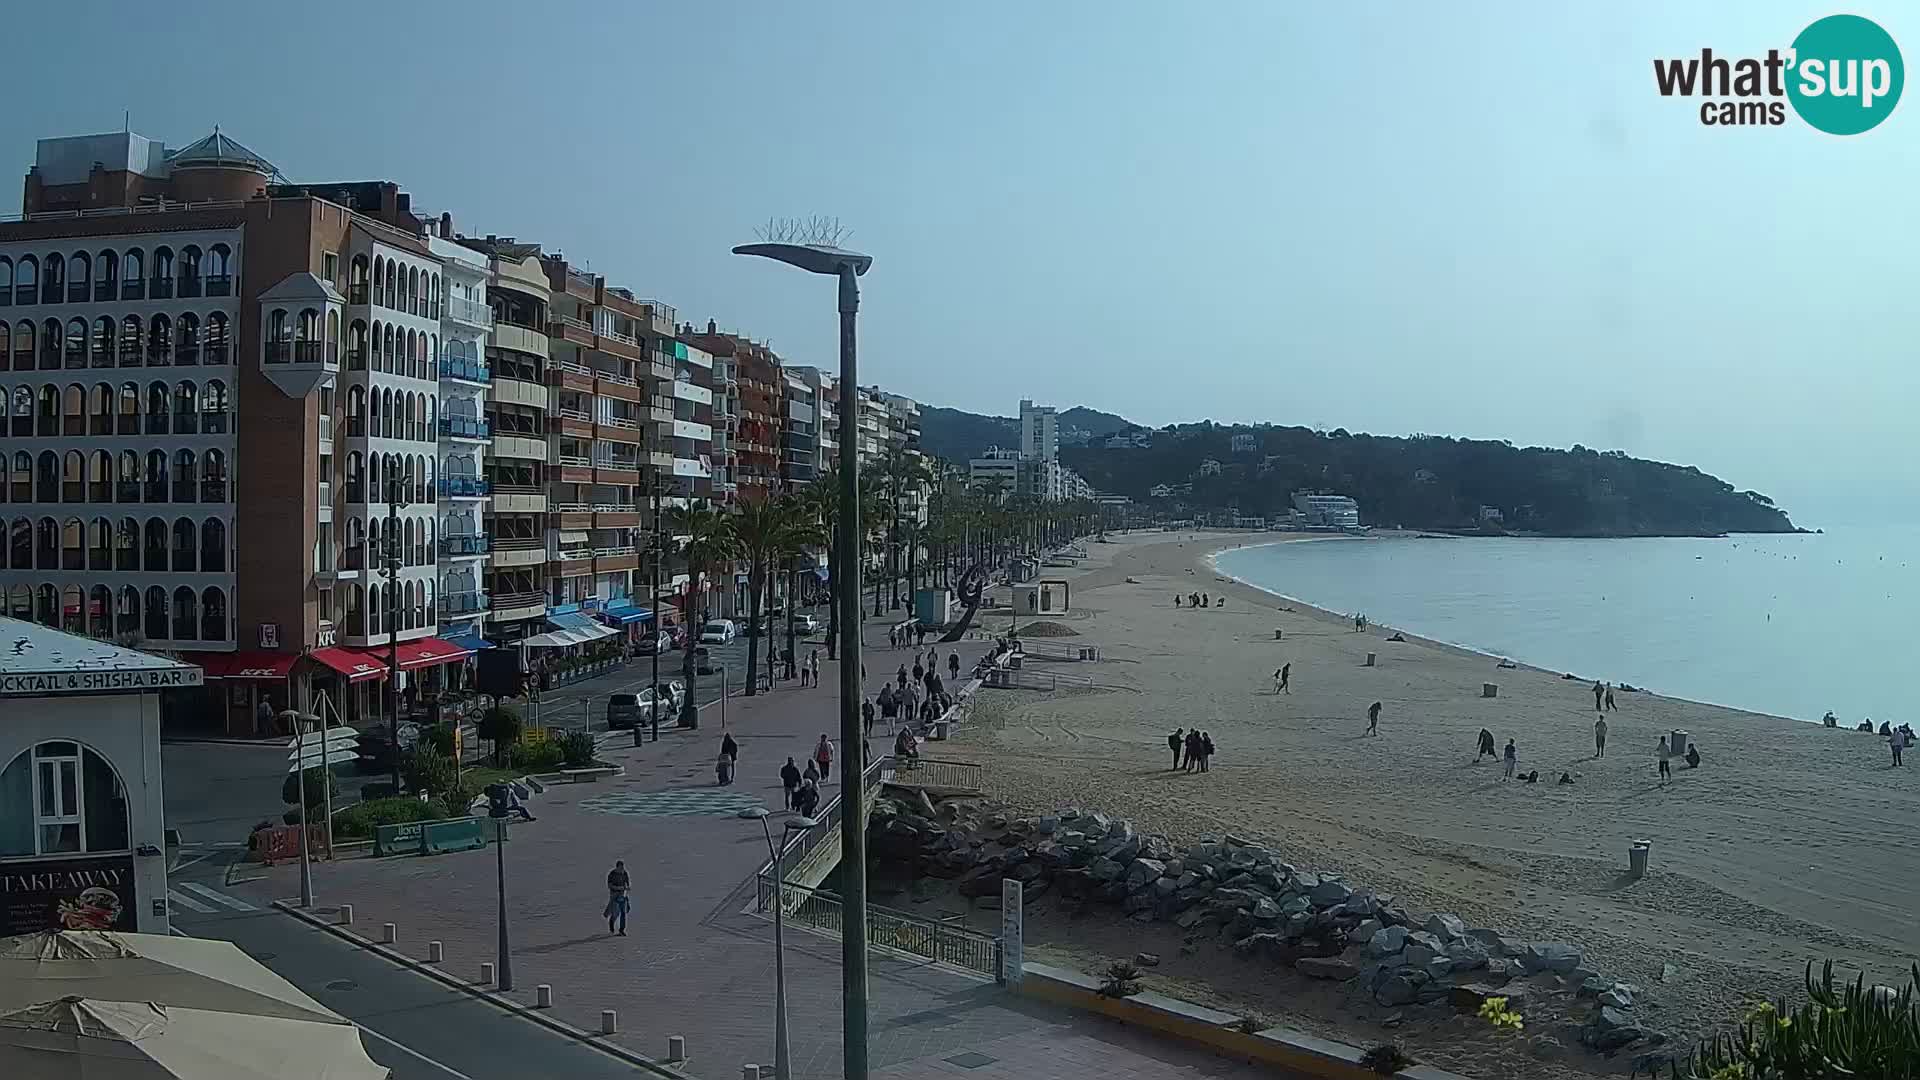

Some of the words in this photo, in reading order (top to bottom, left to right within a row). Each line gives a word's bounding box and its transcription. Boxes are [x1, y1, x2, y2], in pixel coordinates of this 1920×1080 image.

[319, 630, 337, 647] KFC
[67, 676, 78, 688] &
[84, 673, 145, 688] SHISHA
[150, 671, 182, 685] BAR
